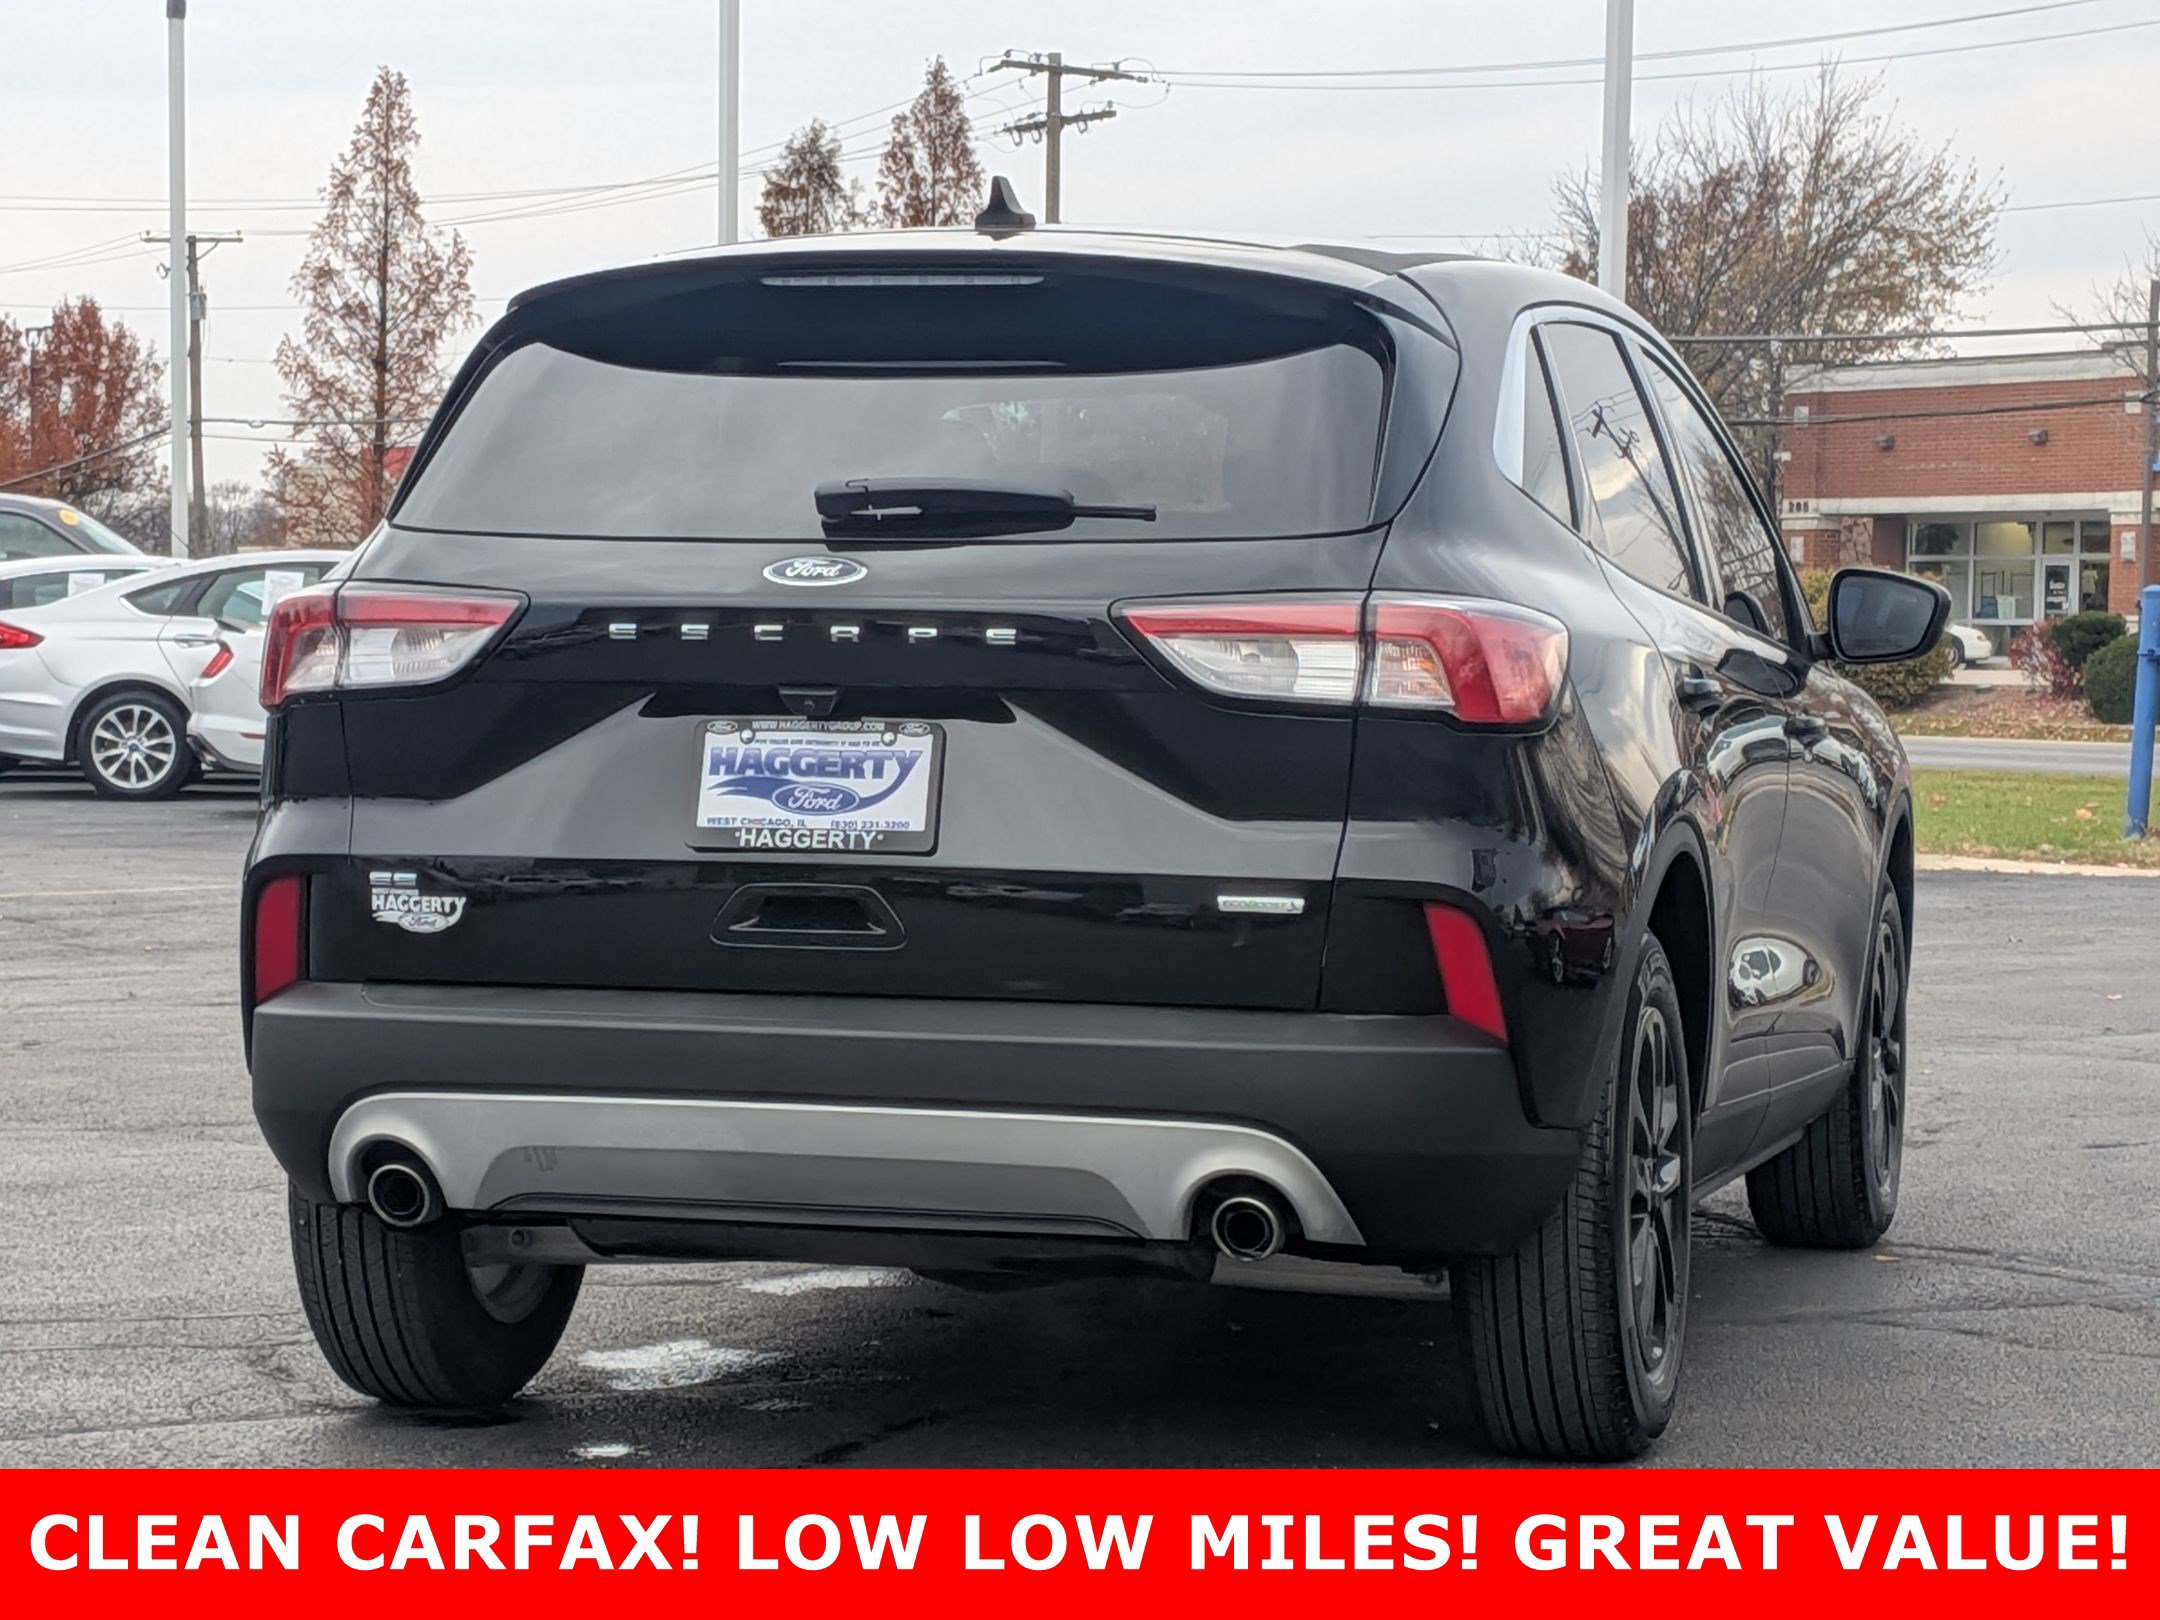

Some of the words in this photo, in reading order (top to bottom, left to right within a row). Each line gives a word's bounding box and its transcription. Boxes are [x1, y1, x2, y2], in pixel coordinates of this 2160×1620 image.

[785, 559, 843, 577] Ford
[608, 623, 1017, 645] ESCAPE
[708, 747, 923, 780] HAGGERTY
[787, 788, 841, 810] Ford
[707, 817, 736, 826] WEST
[739, 828, 876, 849] HAGGERTY
[371, 894, 467, 914] HAGGERTY
